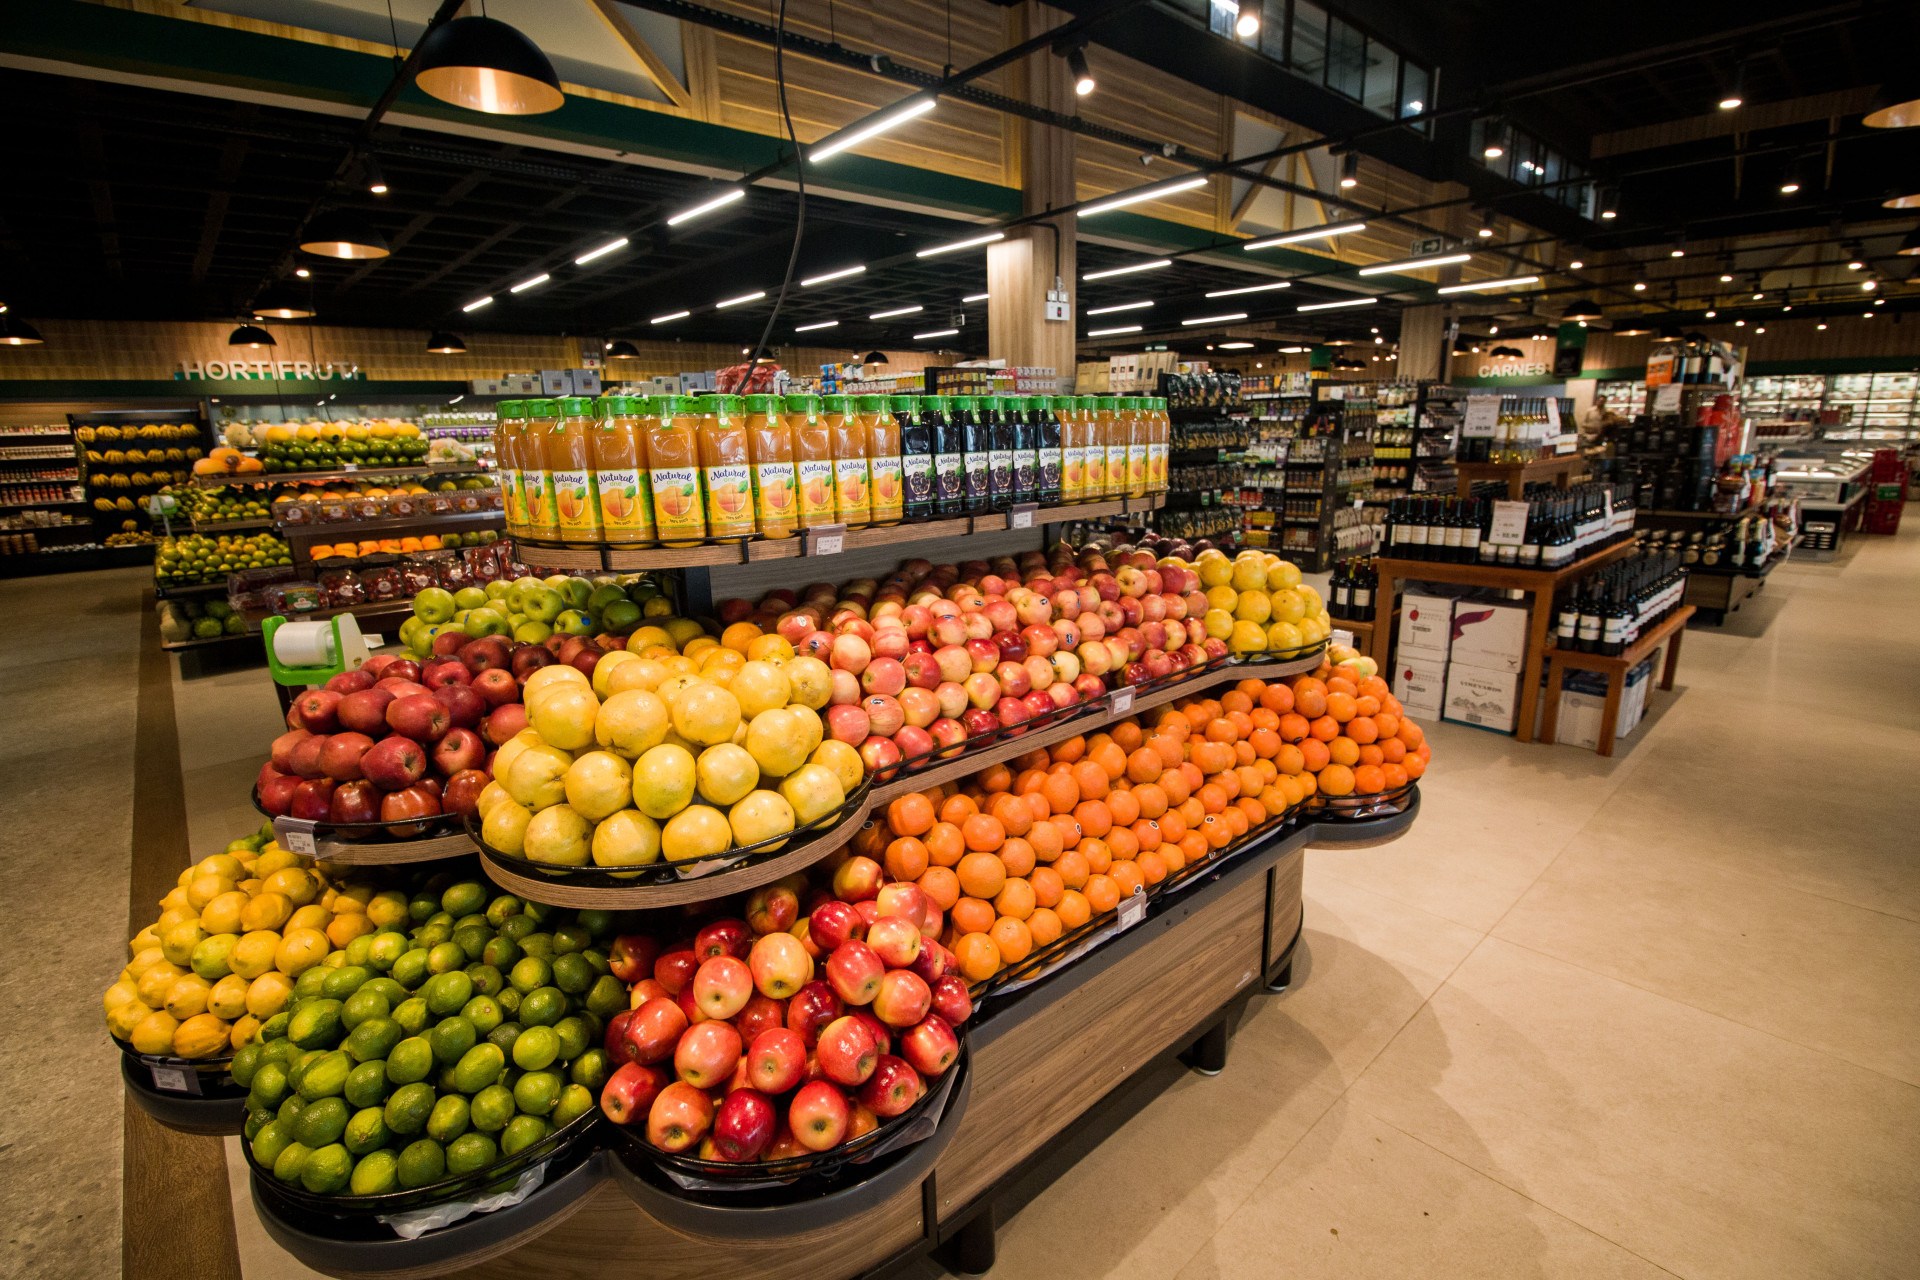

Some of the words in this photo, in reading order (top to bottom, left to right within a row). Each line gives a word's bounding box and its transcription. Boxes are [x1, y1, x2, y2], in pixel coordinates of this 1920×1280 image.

[182, 360, 359, 381] HORTIFRUTI
[1478, 362, 1546, 378] CARNES
[938, 456, 960, 466] Natural
[990, 453, 1011, 462] Natural
[1015, 452, 1035, 461] Natural
[838, 461, 866, 472] Natural
[873, 460, 900, 470] Natural
[905, 458, 931, 467] Natural
[761, 466, 793, 477] Natural
[801, 463, 831, 475] Natural
[554, 474, 584, 485] Natural
[599, 473, 635, 485] Natural
[653, 471, 692, 484] Natural
[711, 469, 748, 481] Natural
